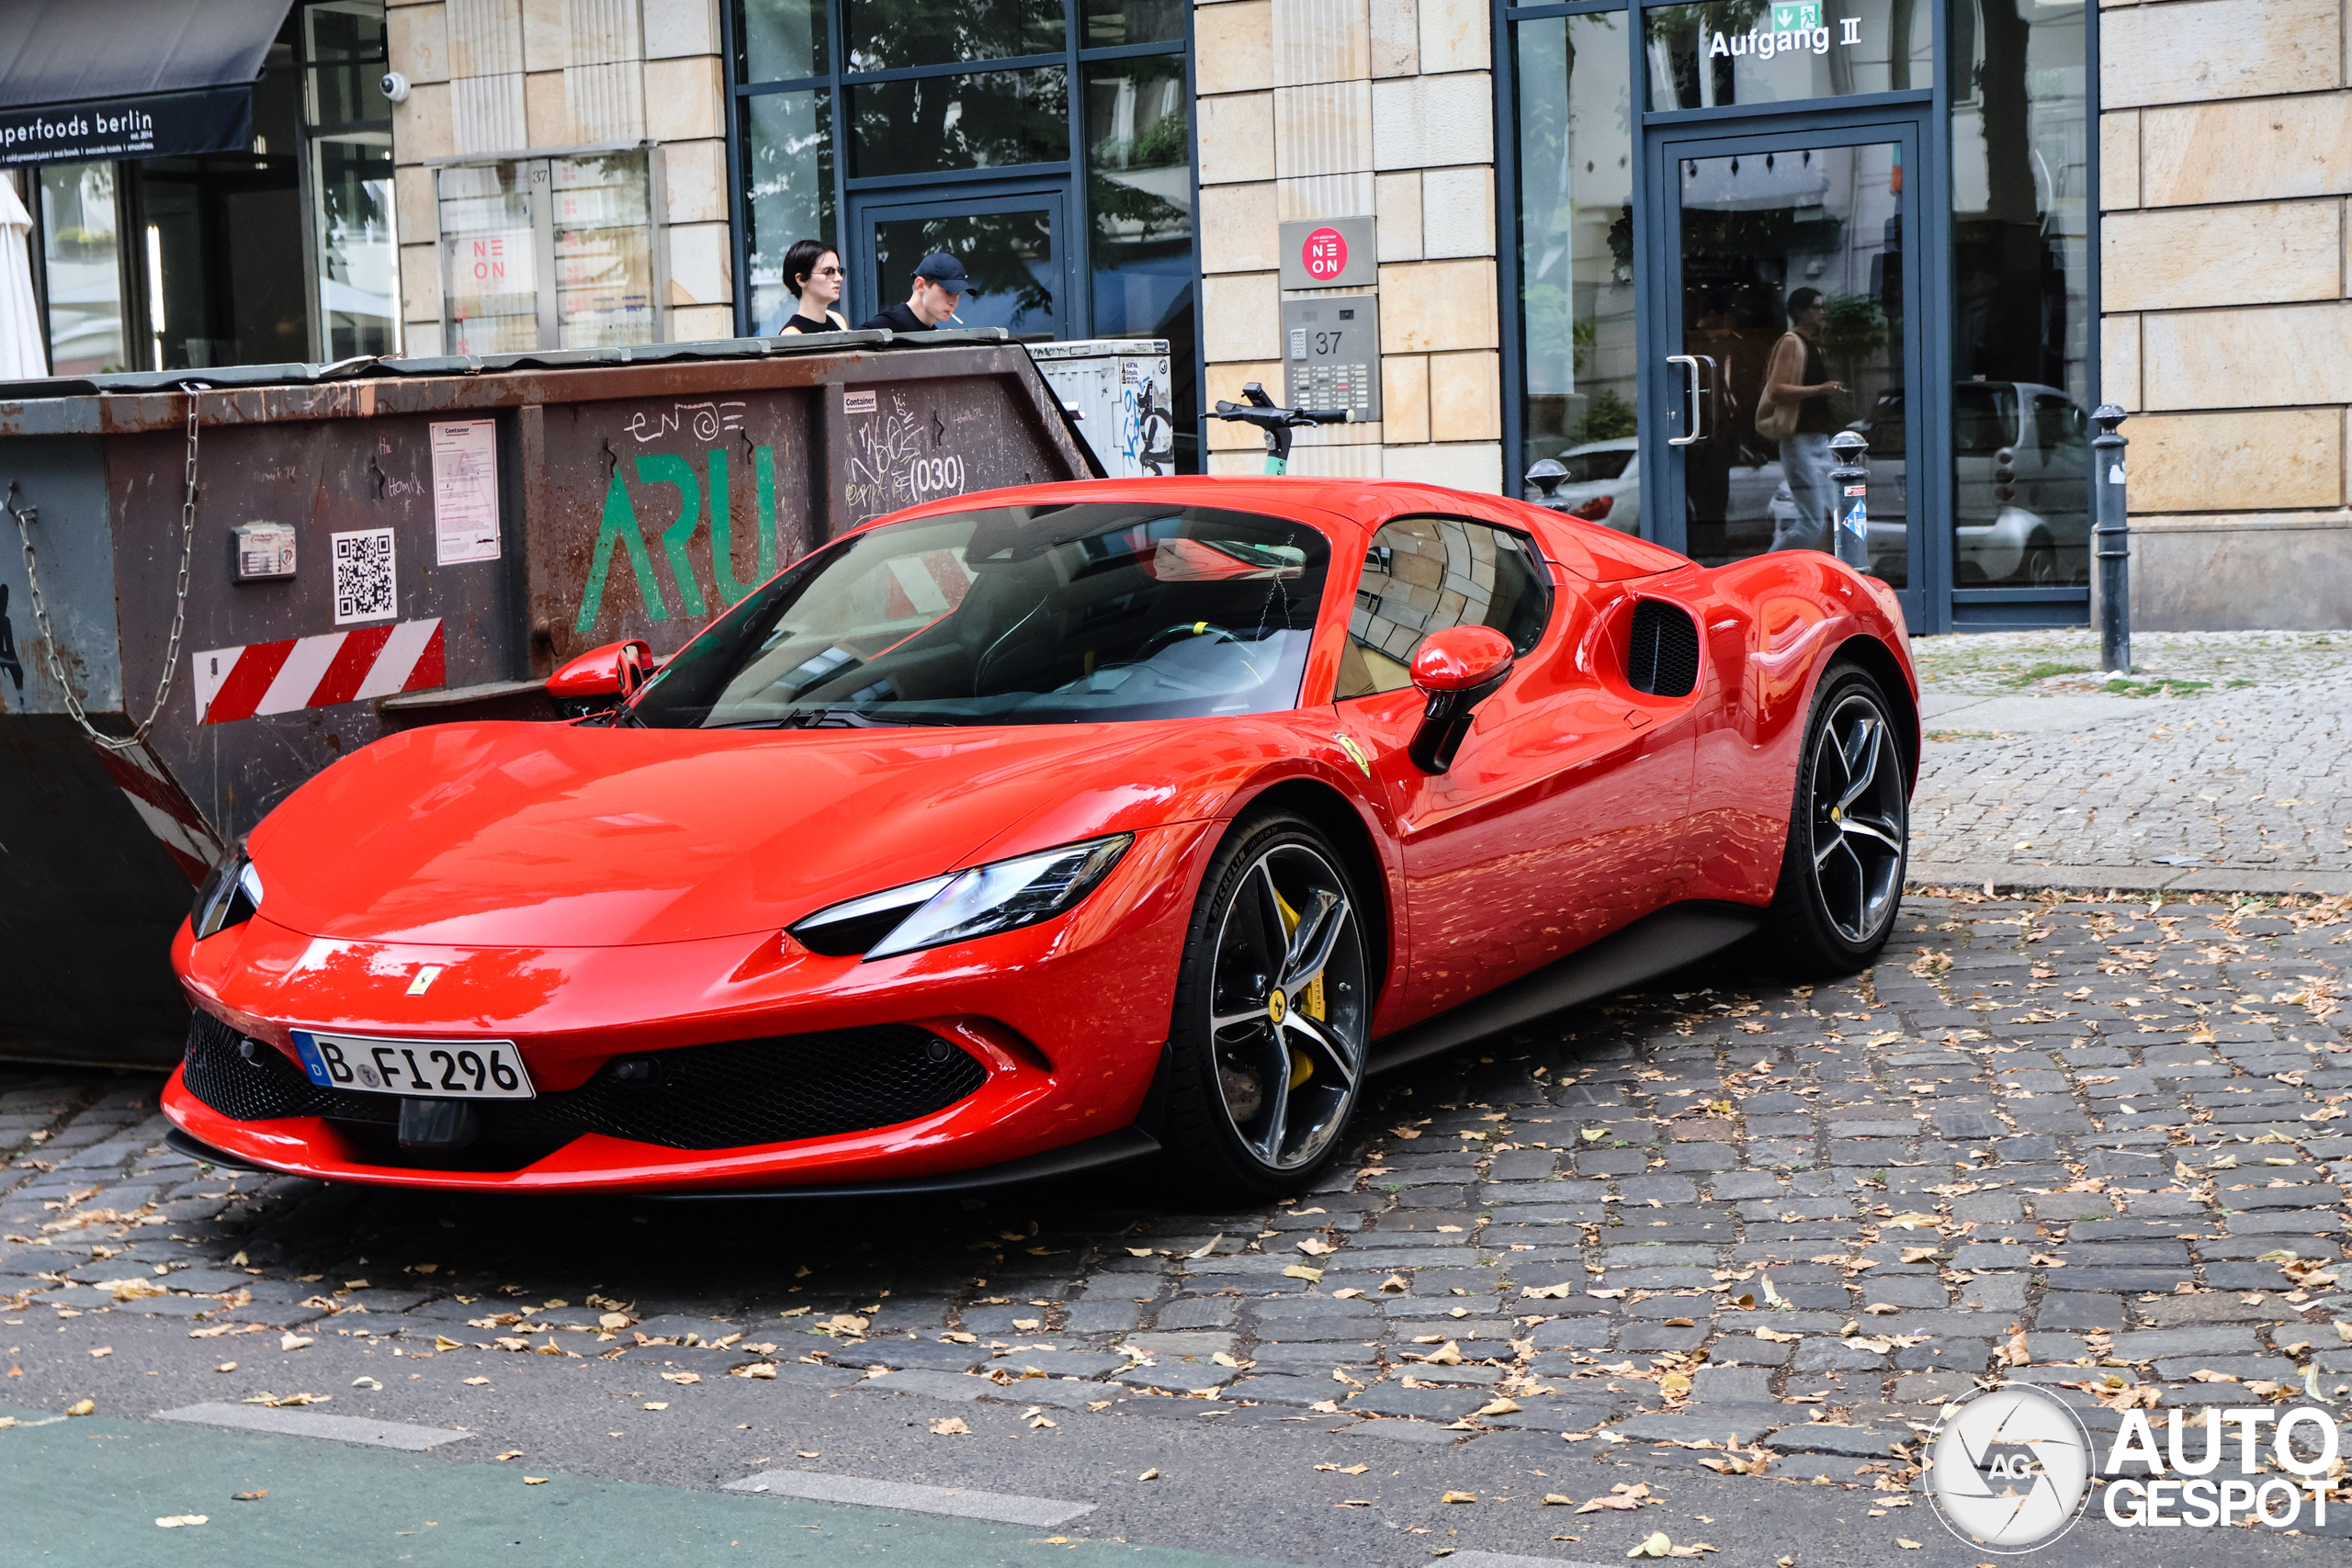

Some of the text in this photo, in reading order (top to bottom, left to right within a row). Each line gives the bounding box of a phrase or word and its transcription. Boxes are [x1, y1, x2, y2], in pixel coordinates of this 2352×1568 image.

[1708, 26, 1829, 61] Aufgang
[0, 108, 153, 148] perfoods berlin
[533, 170, 548, 184] 37
[1316, 331, 1343, 355] 37
[846, 397, 875, 406] Container
[910, 454, 965, 502] (030)
[1801, 754, 1811, 844] MICHELIN
[1212, 850, 1246, 919] MICHELIN
[311, 1063, 322, 1077] D
[319, 1042, 354, 1083] B
